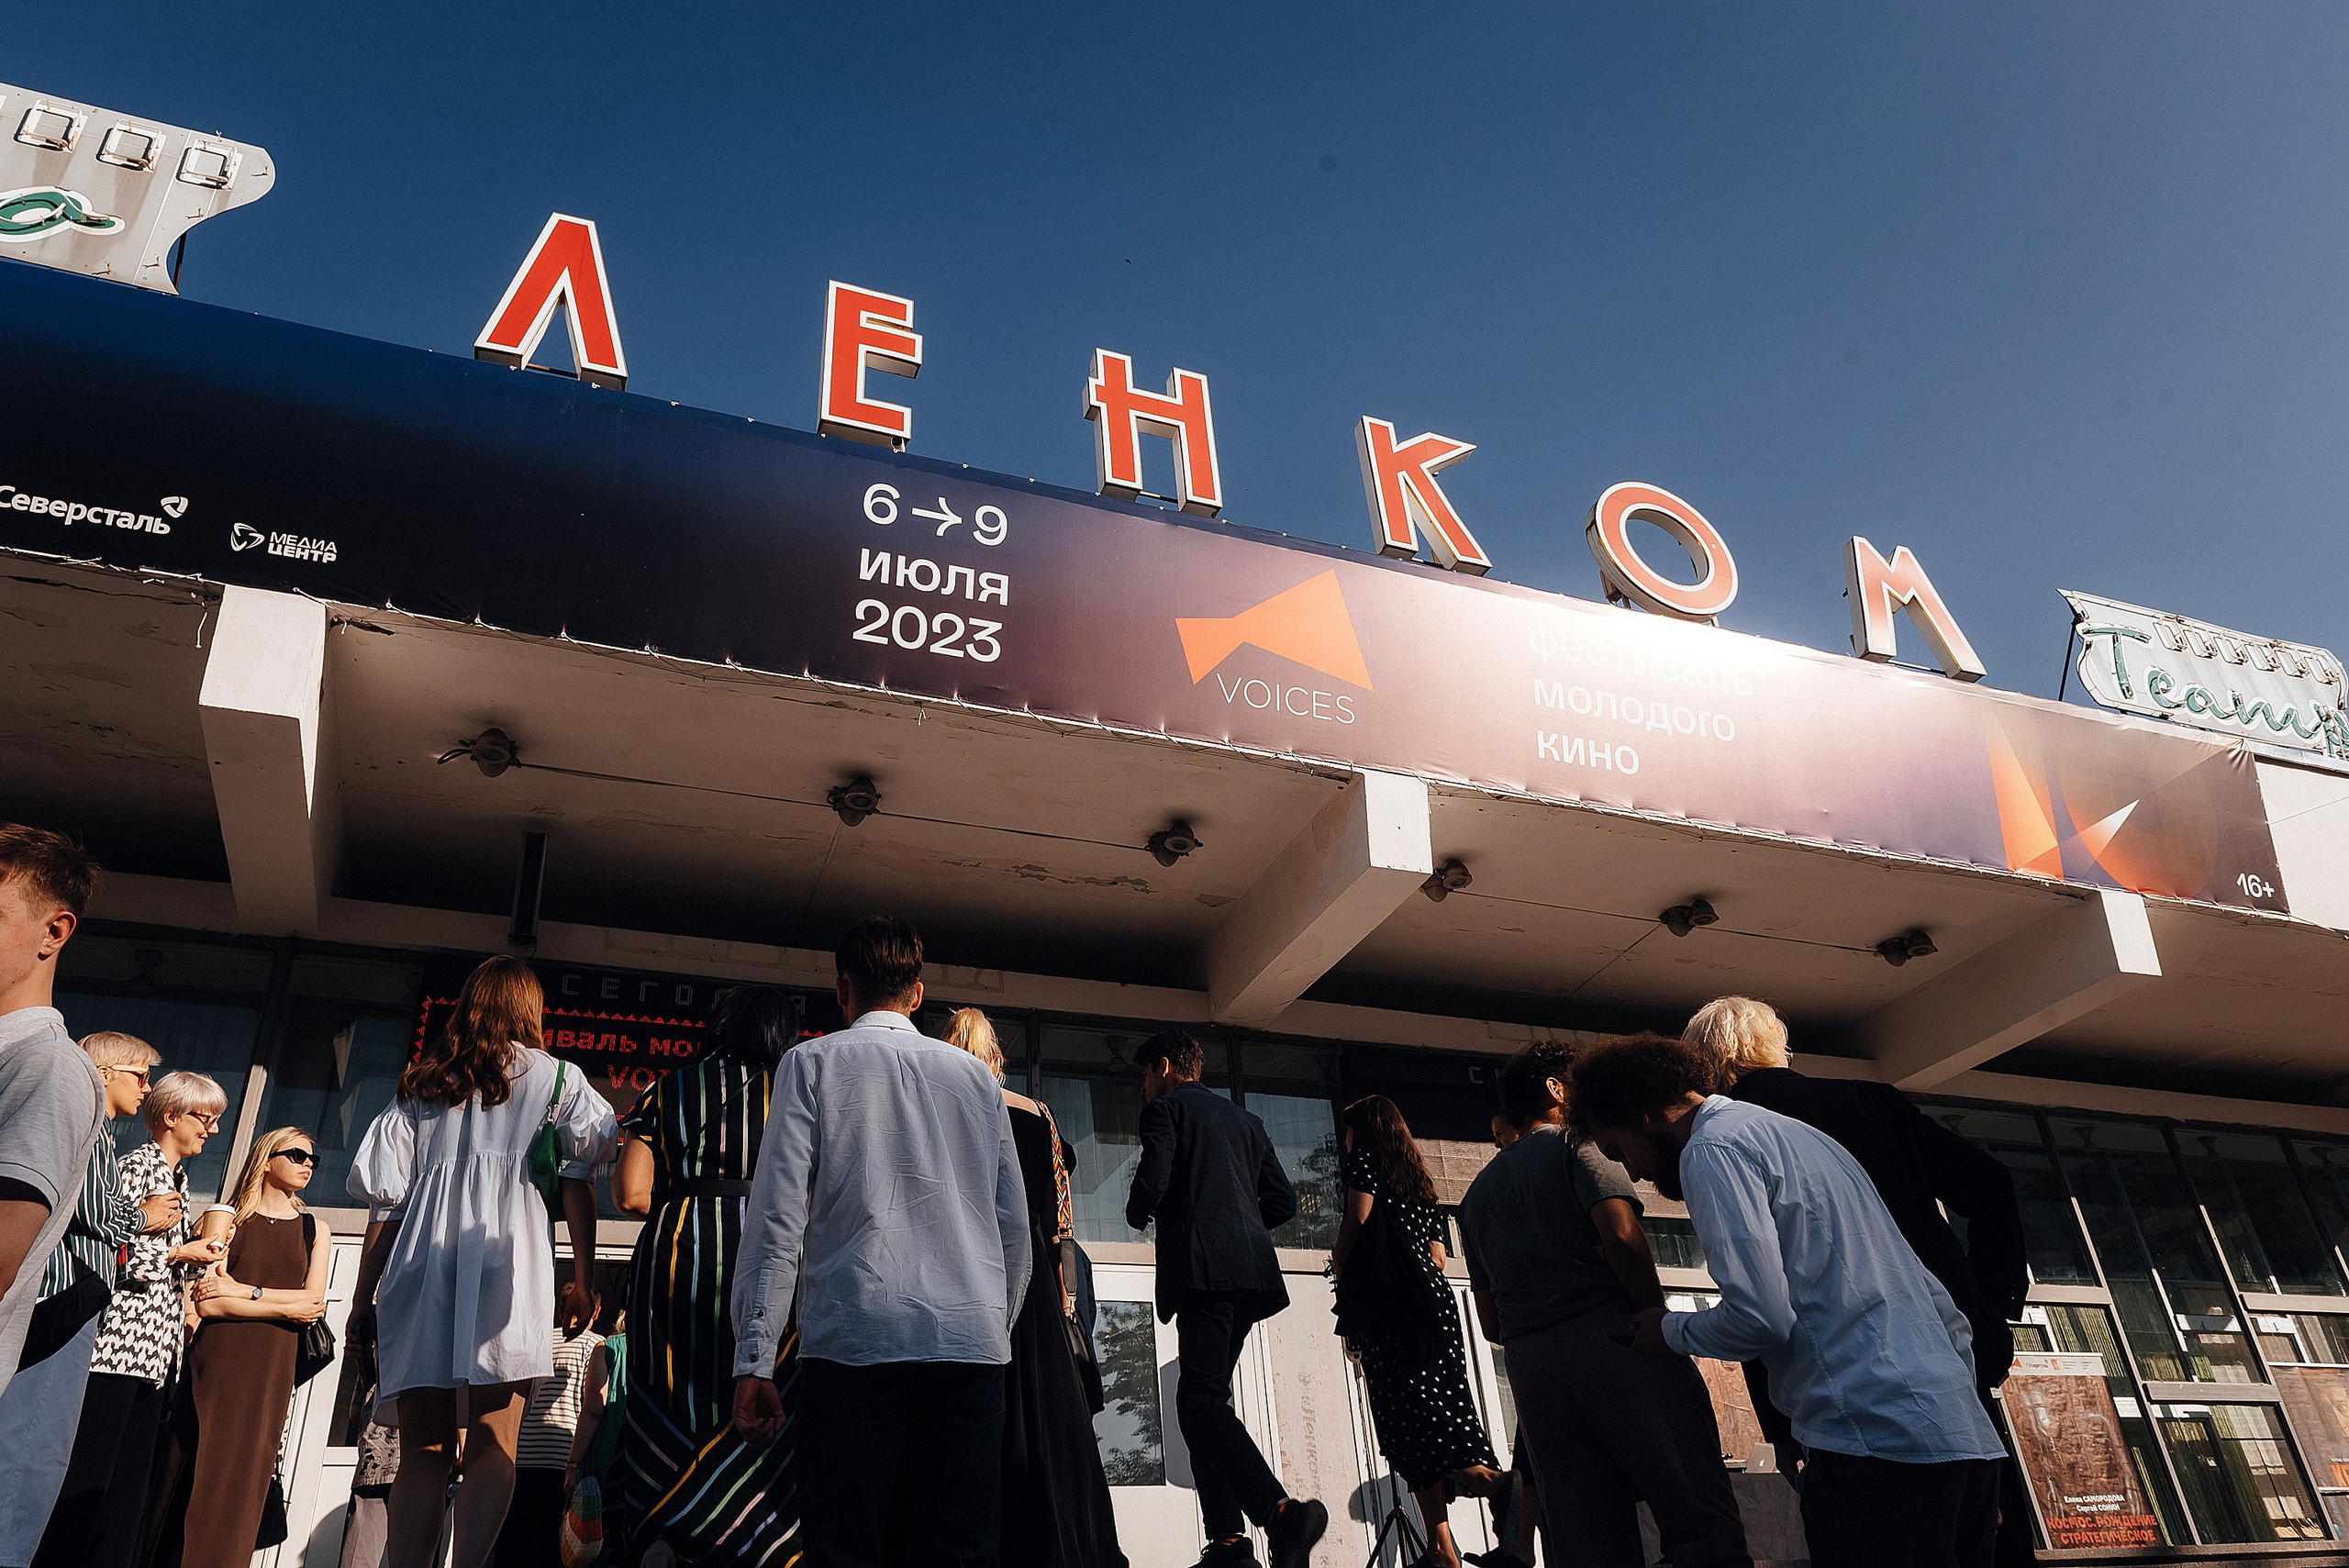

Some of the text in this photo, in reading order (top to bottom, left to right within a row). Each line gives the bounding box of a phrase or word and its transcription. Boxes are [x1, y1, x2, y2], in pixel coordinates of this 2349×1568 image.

[473, 211, 1987, 684] ЛЕНКОМ
[0, 485, 171, 535] Северсталь
[863, 483, 1008, 547] 6 9
[268, 546, 337, 563] ЦЕНТР
[852, 598, 1003, 663] 2023
[1216, 673, 1355, 725] VOICES
[2236, 873, 2275, 898] 16+
[2060, 1529, 2156, 1545] СТРАТЕГИЧЕСКОЕ
